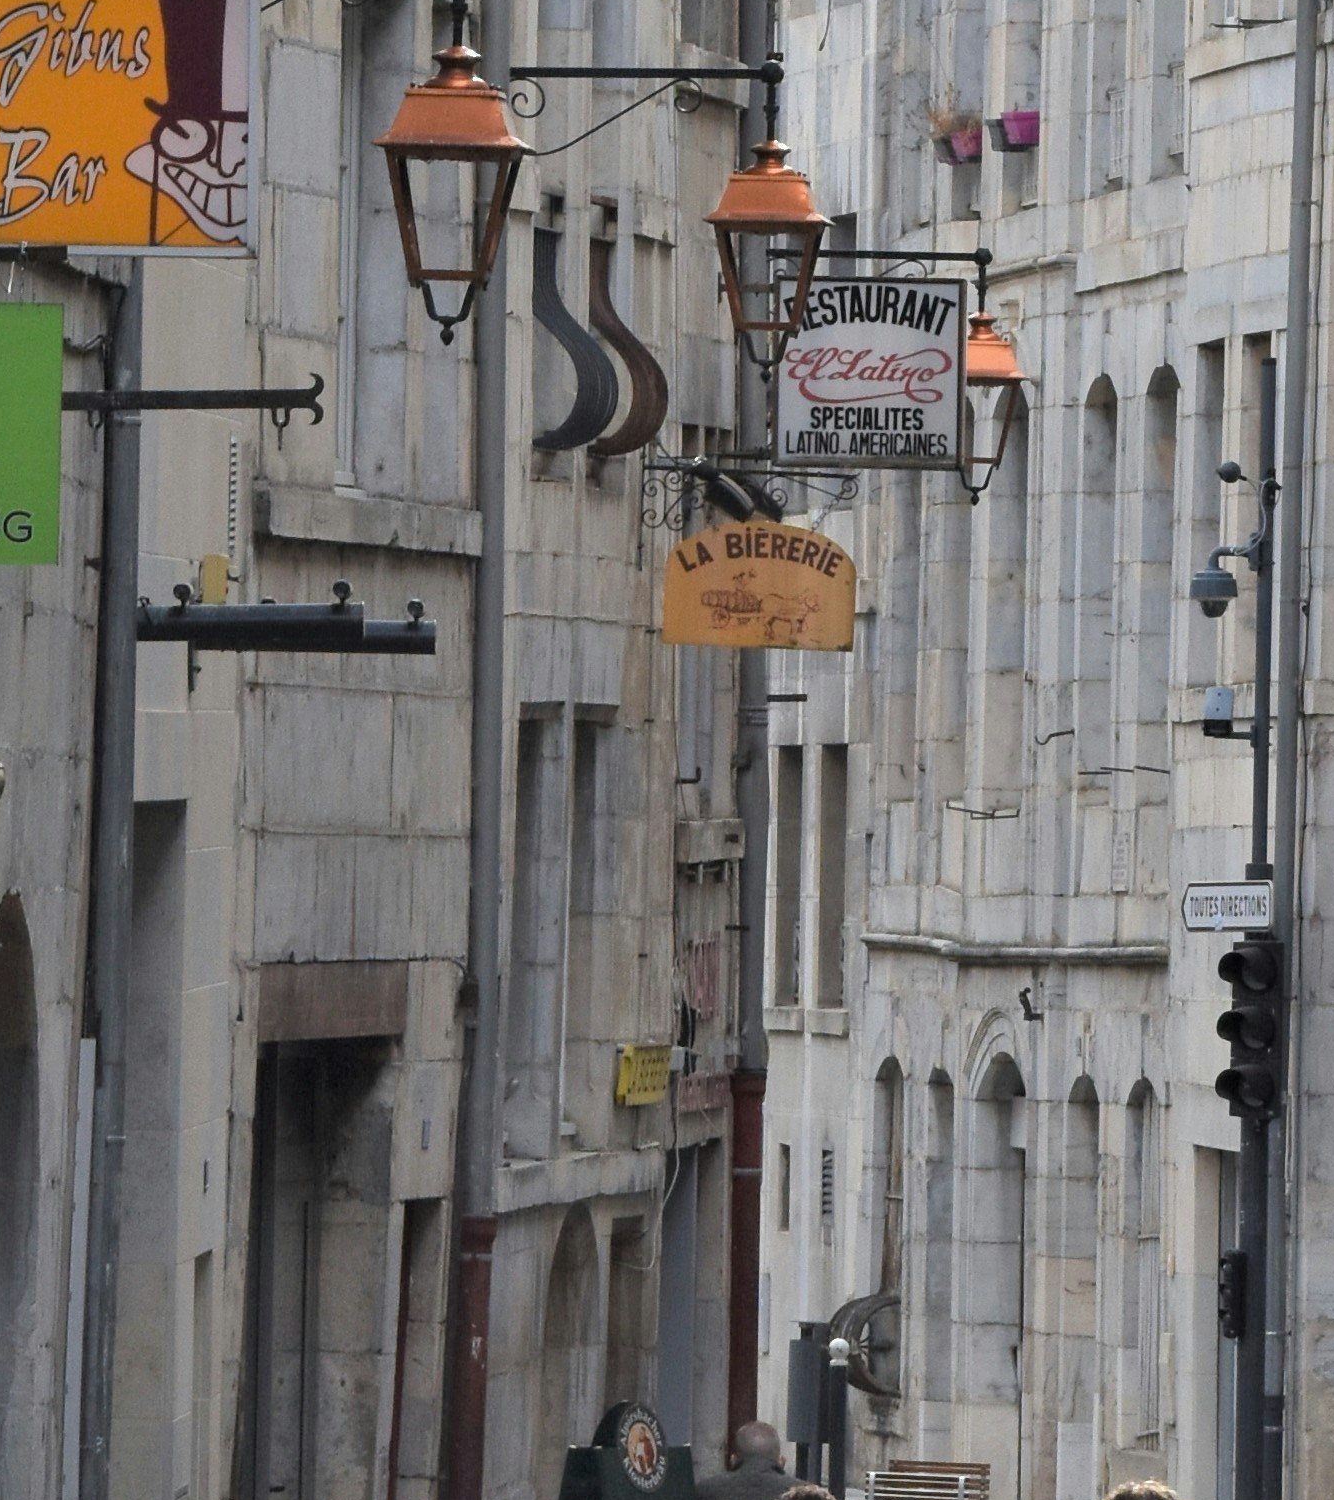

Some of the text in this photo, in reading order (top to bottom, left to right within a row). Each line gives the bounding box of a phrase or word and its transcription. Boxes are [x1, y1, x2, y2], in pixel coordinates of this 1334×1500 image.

[828, 347, 953, 403] Latino
[810, 406, 924, 431] SPECIALITES
[676, 540, 714, 572] LA
[1189, 894, 1267, 918] TOUTES DIRECTIONS
